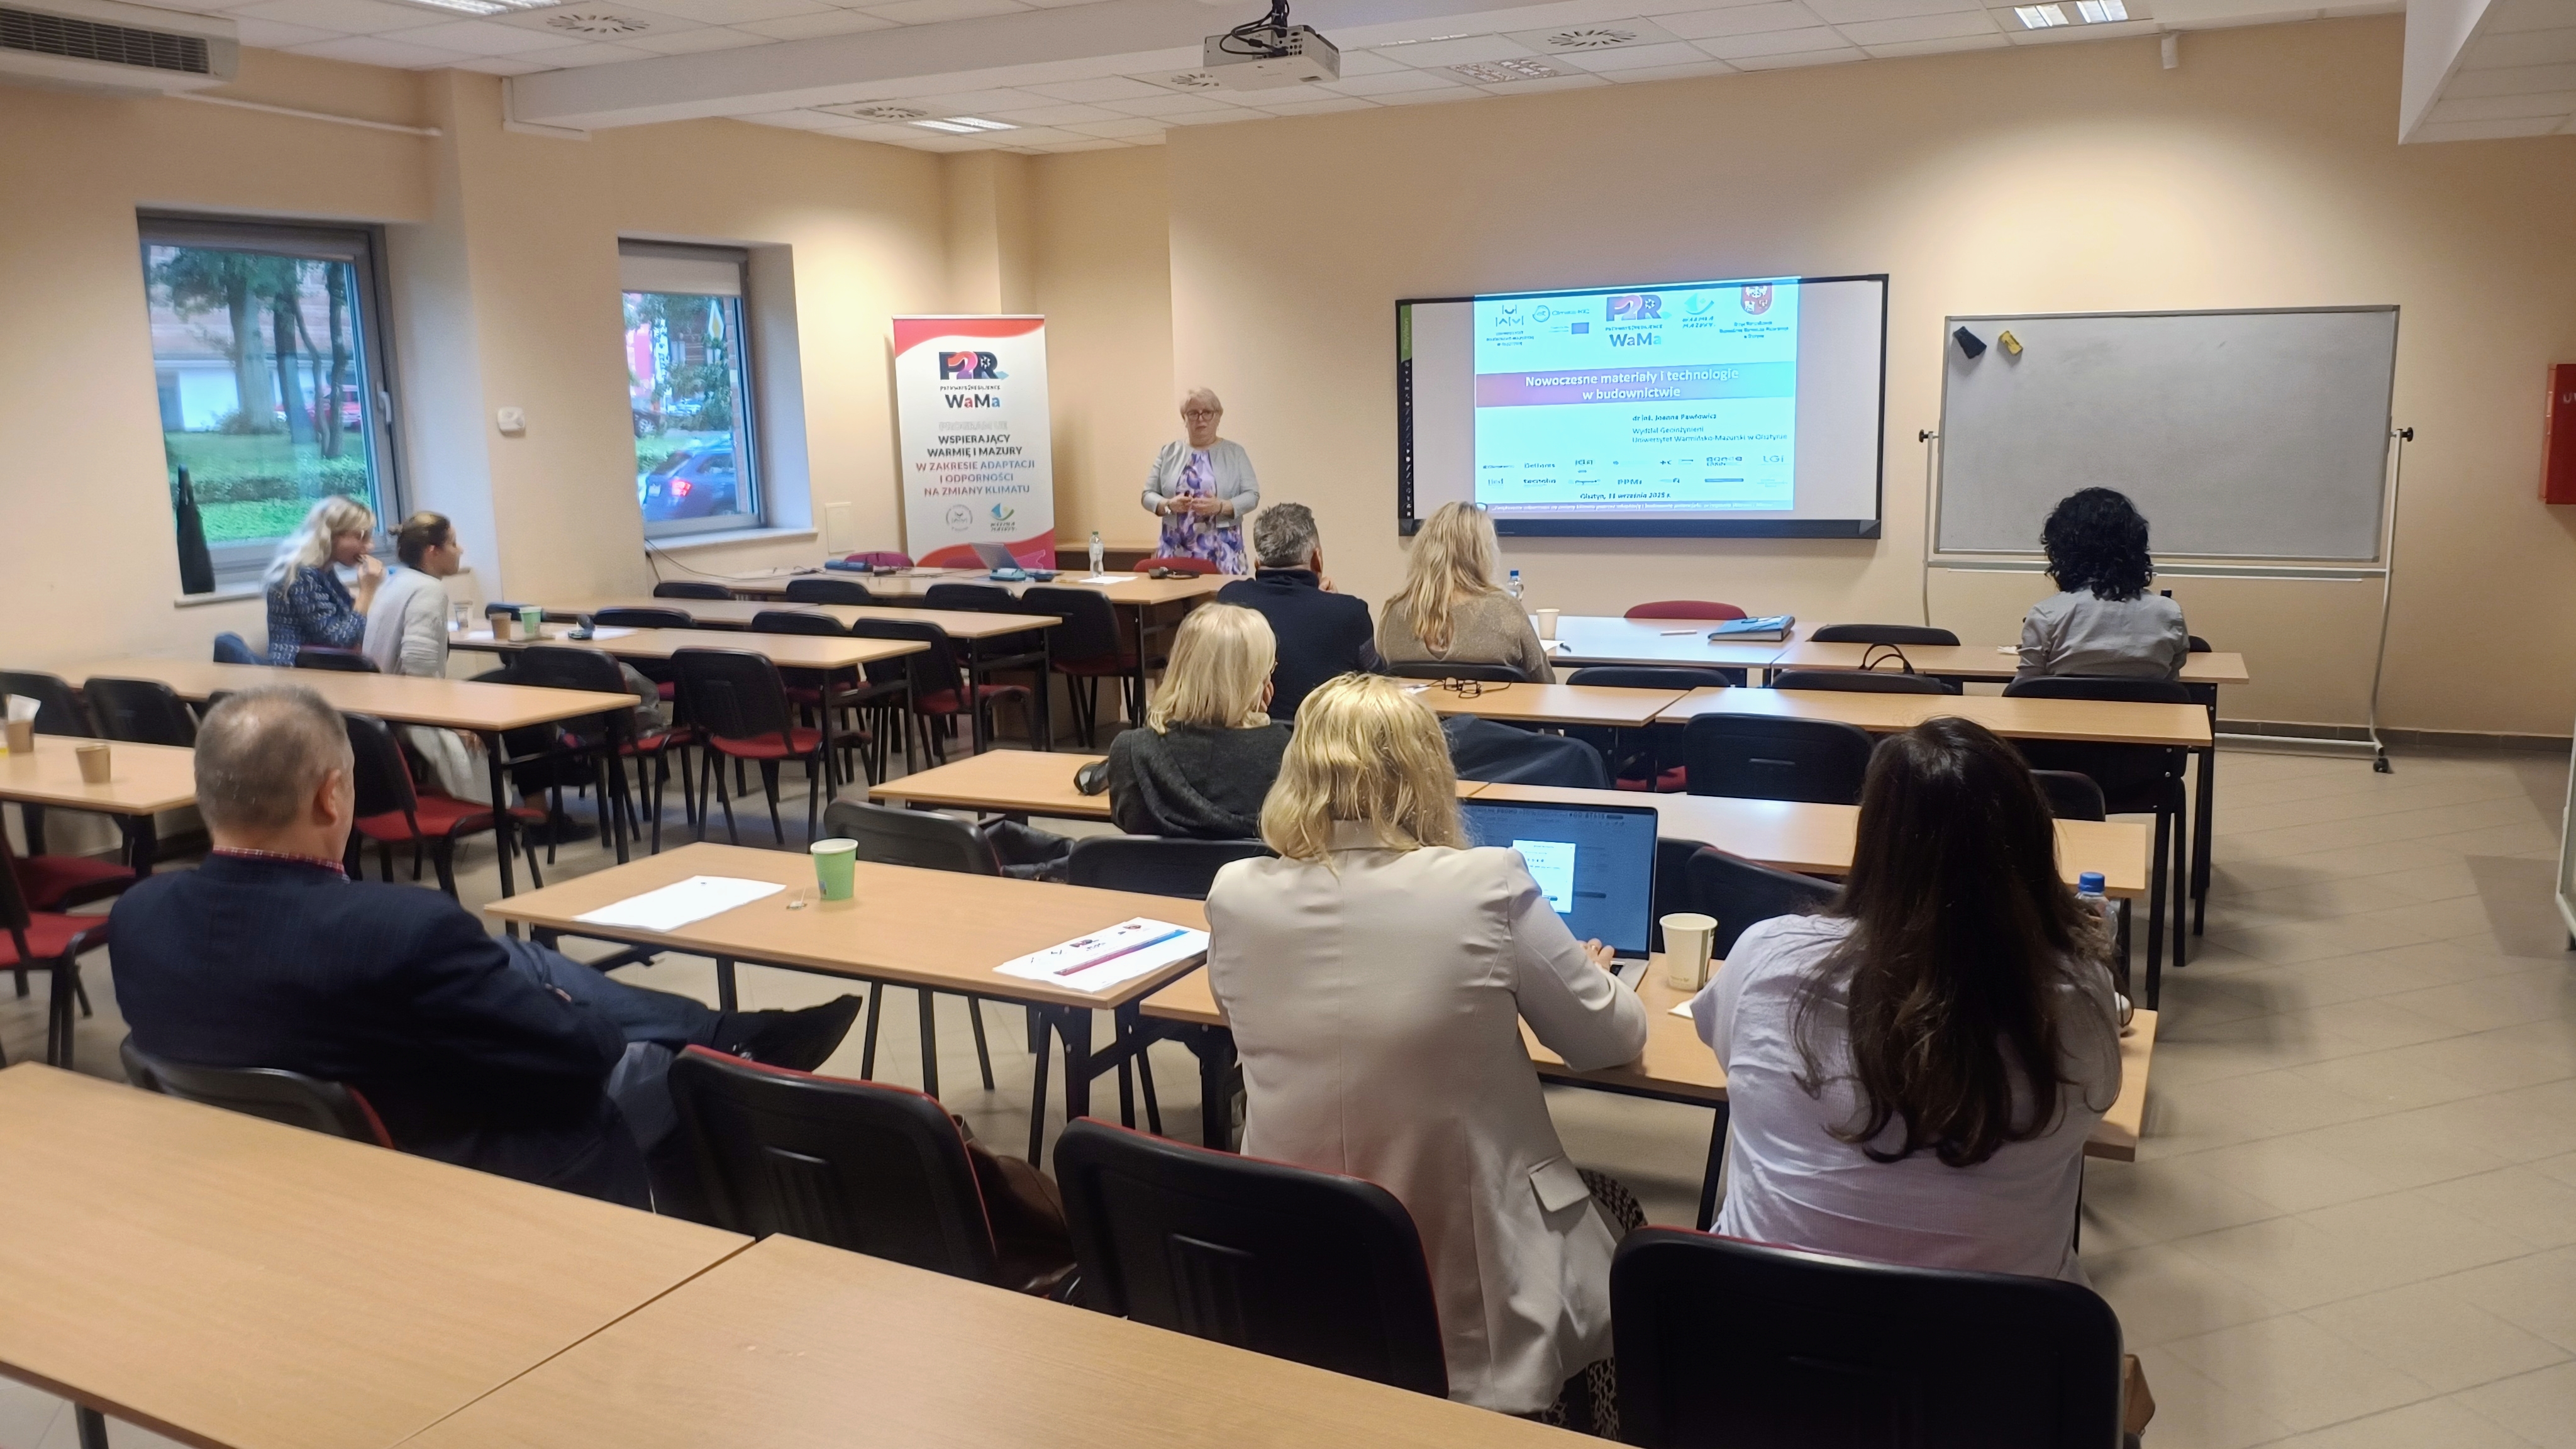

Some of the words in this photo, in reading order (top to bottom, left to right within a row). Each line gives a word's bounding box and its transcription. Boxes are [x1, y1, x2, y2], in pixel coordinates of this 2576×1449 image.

[1606, 295, 1662, 321] P2R
[1609, 332, 1662, 347] WaMa
[939, 351, 999, 380] P2R
[1525, 374, 1597, 387] Nowoczesne
[1601, 371, 1657, 384] materiały
[1660, 370, 1664, 381] i
[1667, 368, 1740, 382] technologie
[1582, 392, 1594, 400] w
[1596, 387, 1681, 399] budownictwie
[945, 394, 1000, 408] WaMa
[938, 434, 1011, 444] WSPIERAJĄCY
[927, 447, 971, 457] WARMIĘ
[974, 447, 977, 456] I
[979, 446, 1023, 456] MAZURY
[916, 462, 927, 472] W
[930, 461, 978, 471] ZAKRESIE
[980, 460, 1035, 469] ADAPTACJI
[940, 475, 943, 484] I
[945, 473, 1013, 483] ODPORNOŚCI
[924, 487, 940, 497] NA
[942, 486, 983, 496] ZMIANY
[985, 485, 1030, 494] KLIMATU
